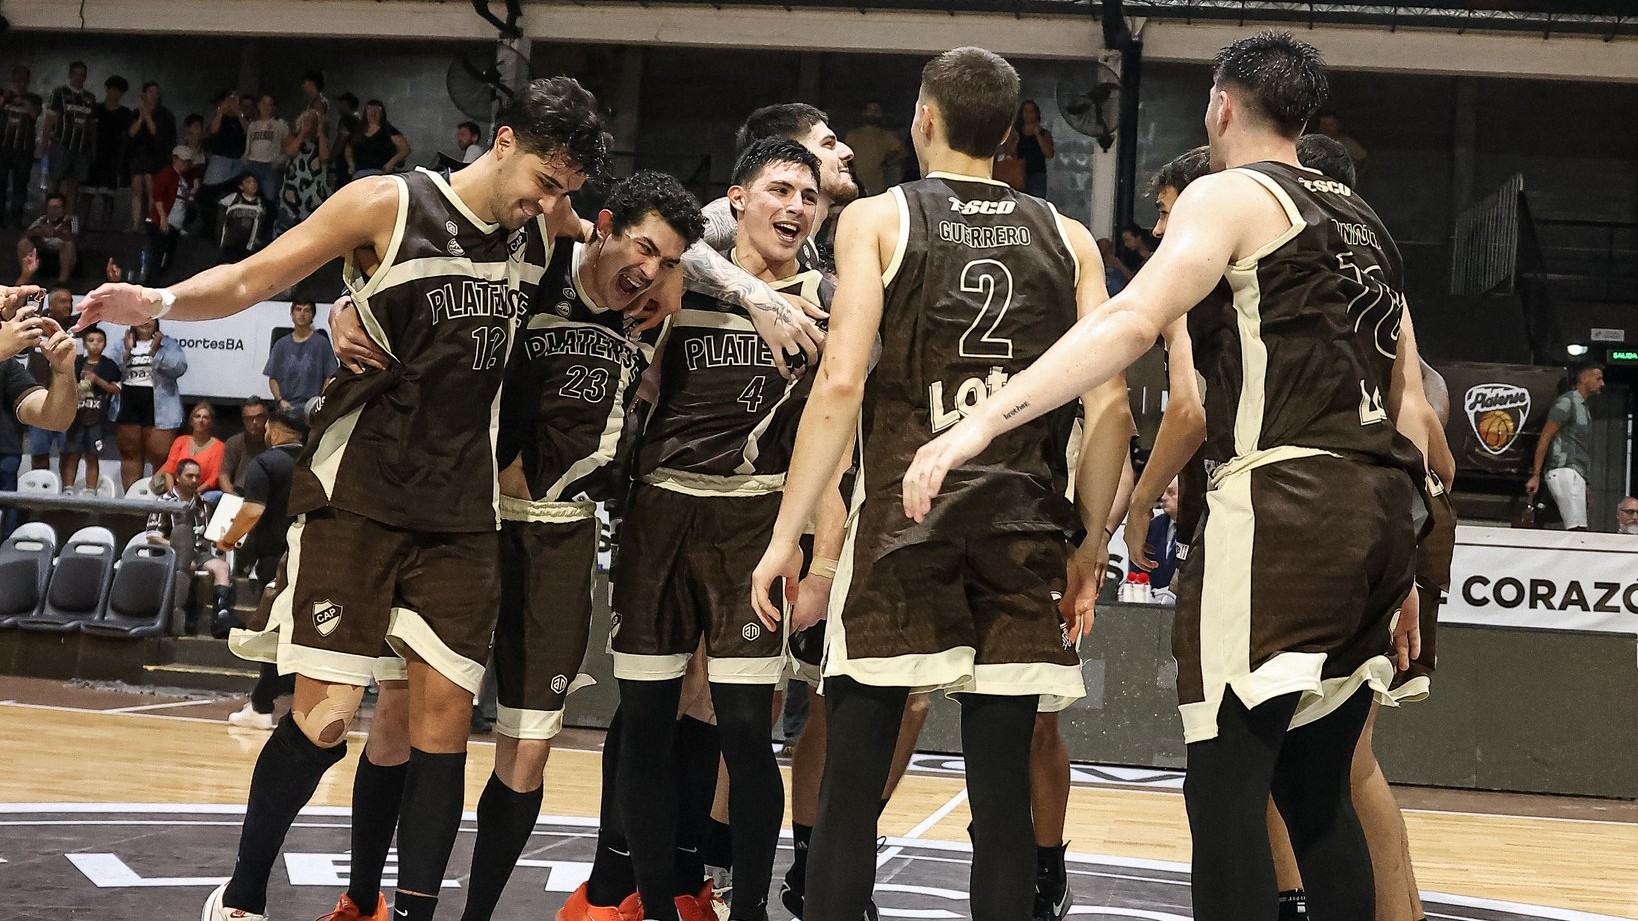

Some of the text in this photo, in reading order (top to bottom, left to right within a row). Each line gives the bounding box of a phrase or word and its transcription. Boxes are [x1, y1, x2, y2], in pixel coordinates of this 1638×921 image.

[938, 220, 1031, 249] GUERRERO
[958, 258, 1014, 359] 2
[174, 338, 244, 351] portesBA
[684, 333, 777, 371] PLATE
[559, 364, 609, 404] 23
[737, 375, 766, 413] 4
[316, 607, 336, 623] CAP
